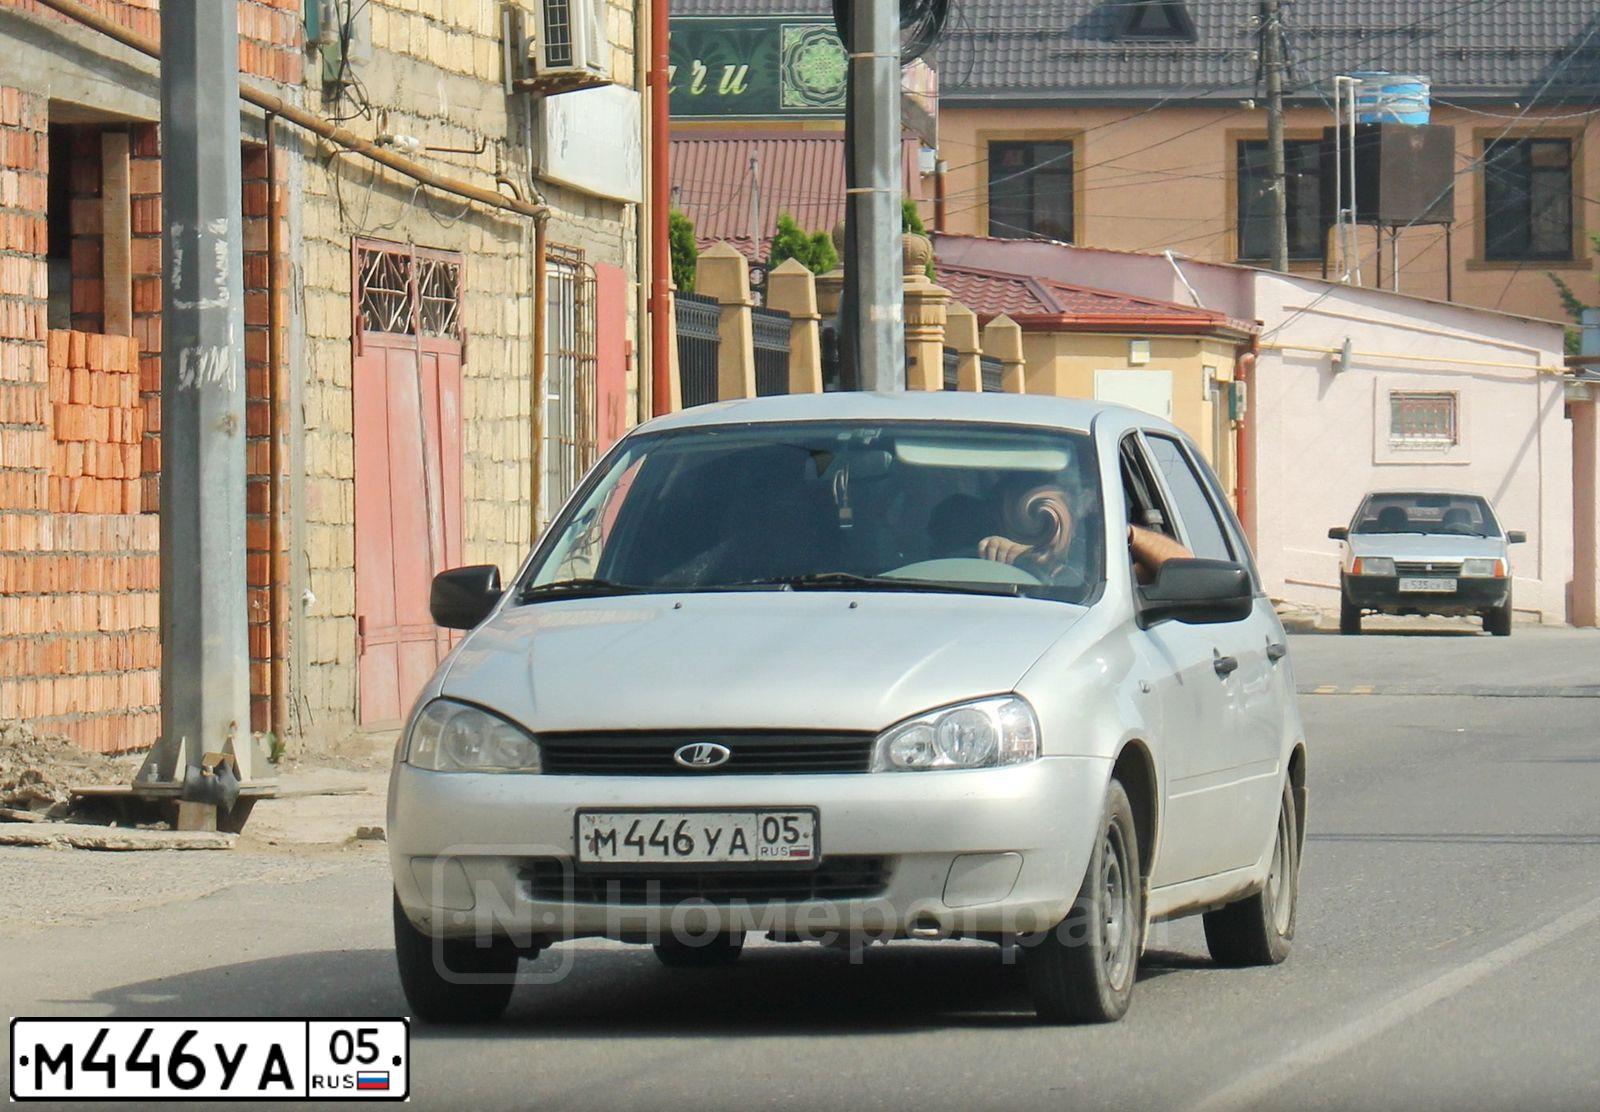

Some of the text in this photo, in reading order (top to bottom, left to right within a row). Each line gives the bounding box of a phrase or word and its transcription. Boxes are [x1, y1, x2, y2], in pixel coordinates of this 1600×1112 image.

[594, 816, 801, 857] М446УА 05
[760, 846, 789, 857] RUS
